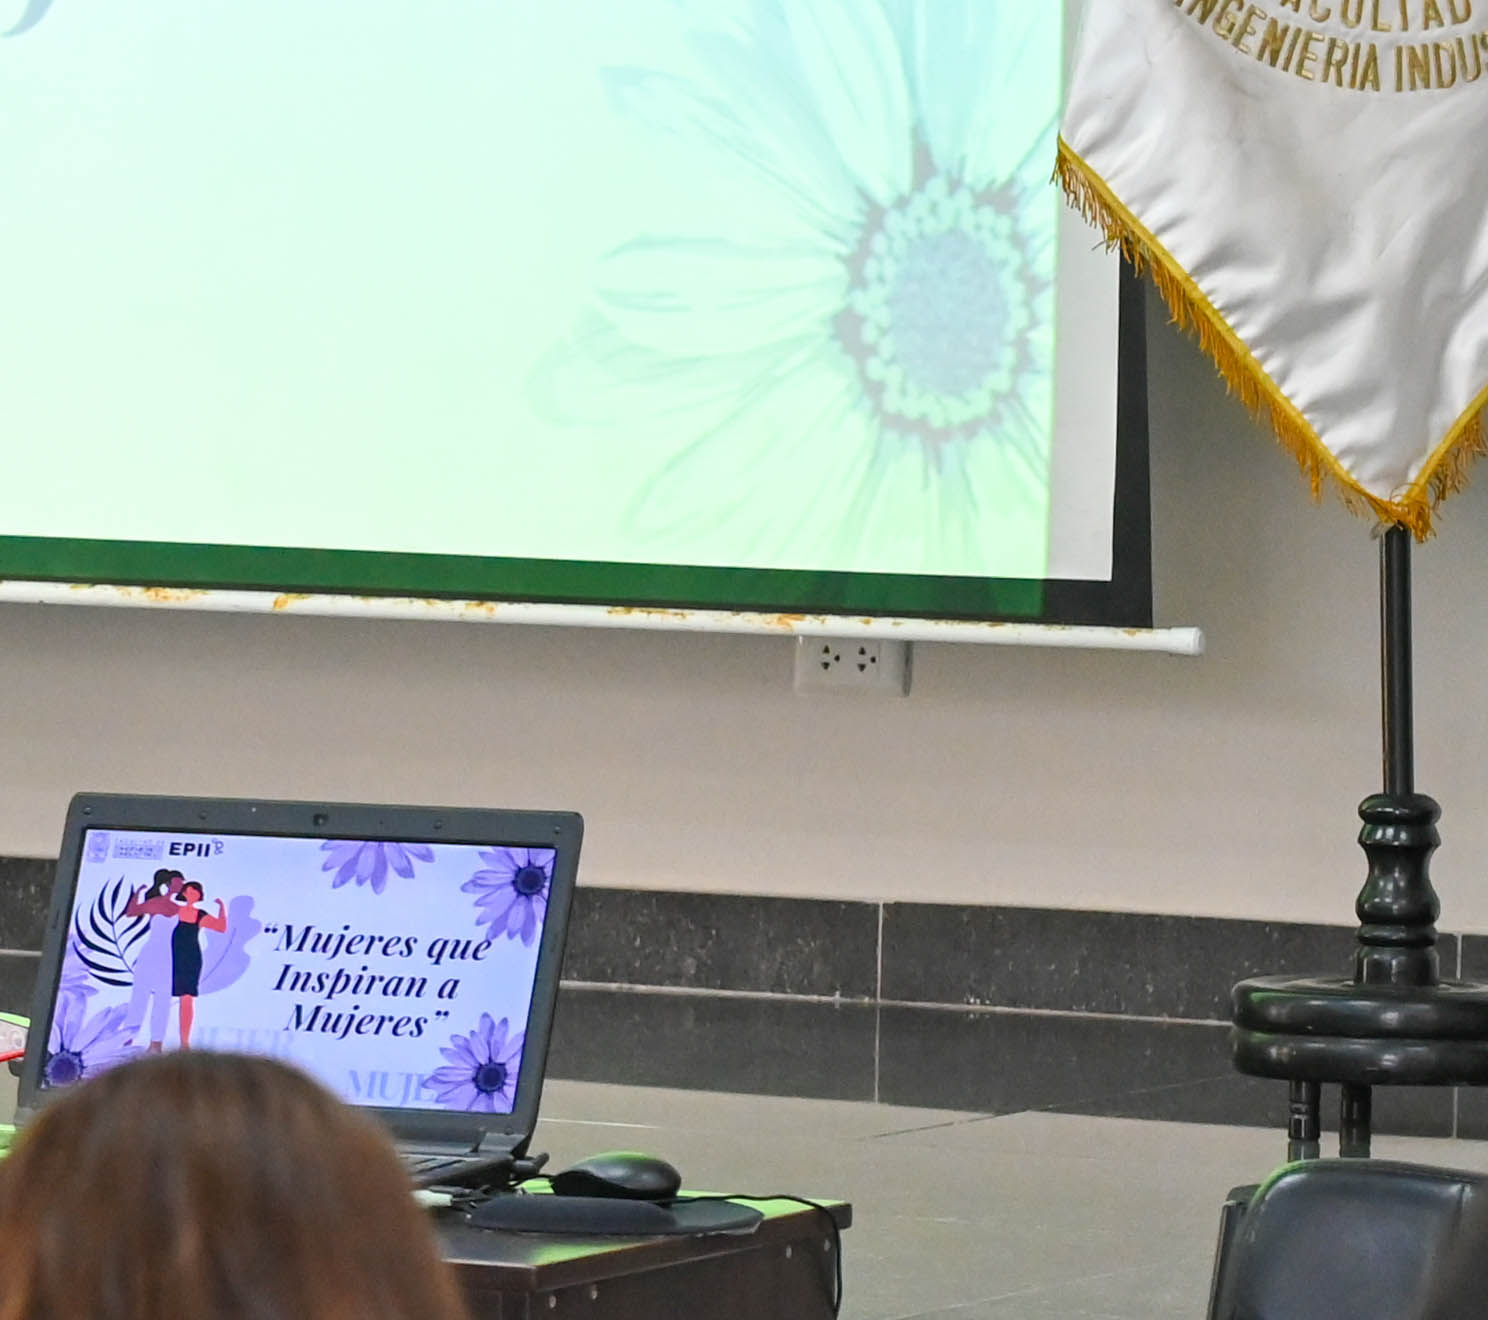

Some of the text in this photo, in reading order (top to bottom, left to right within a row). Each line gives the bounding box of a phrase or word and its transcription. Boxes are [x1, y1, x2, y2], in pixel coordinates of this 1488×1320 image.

[169, 841, 211, 858] EPII
[264, 923, 492, 965] “Mujeres que
[272, 964, 461, 1000] Inspiran a
[283, 1003, 450, 1040] Mujeres”
